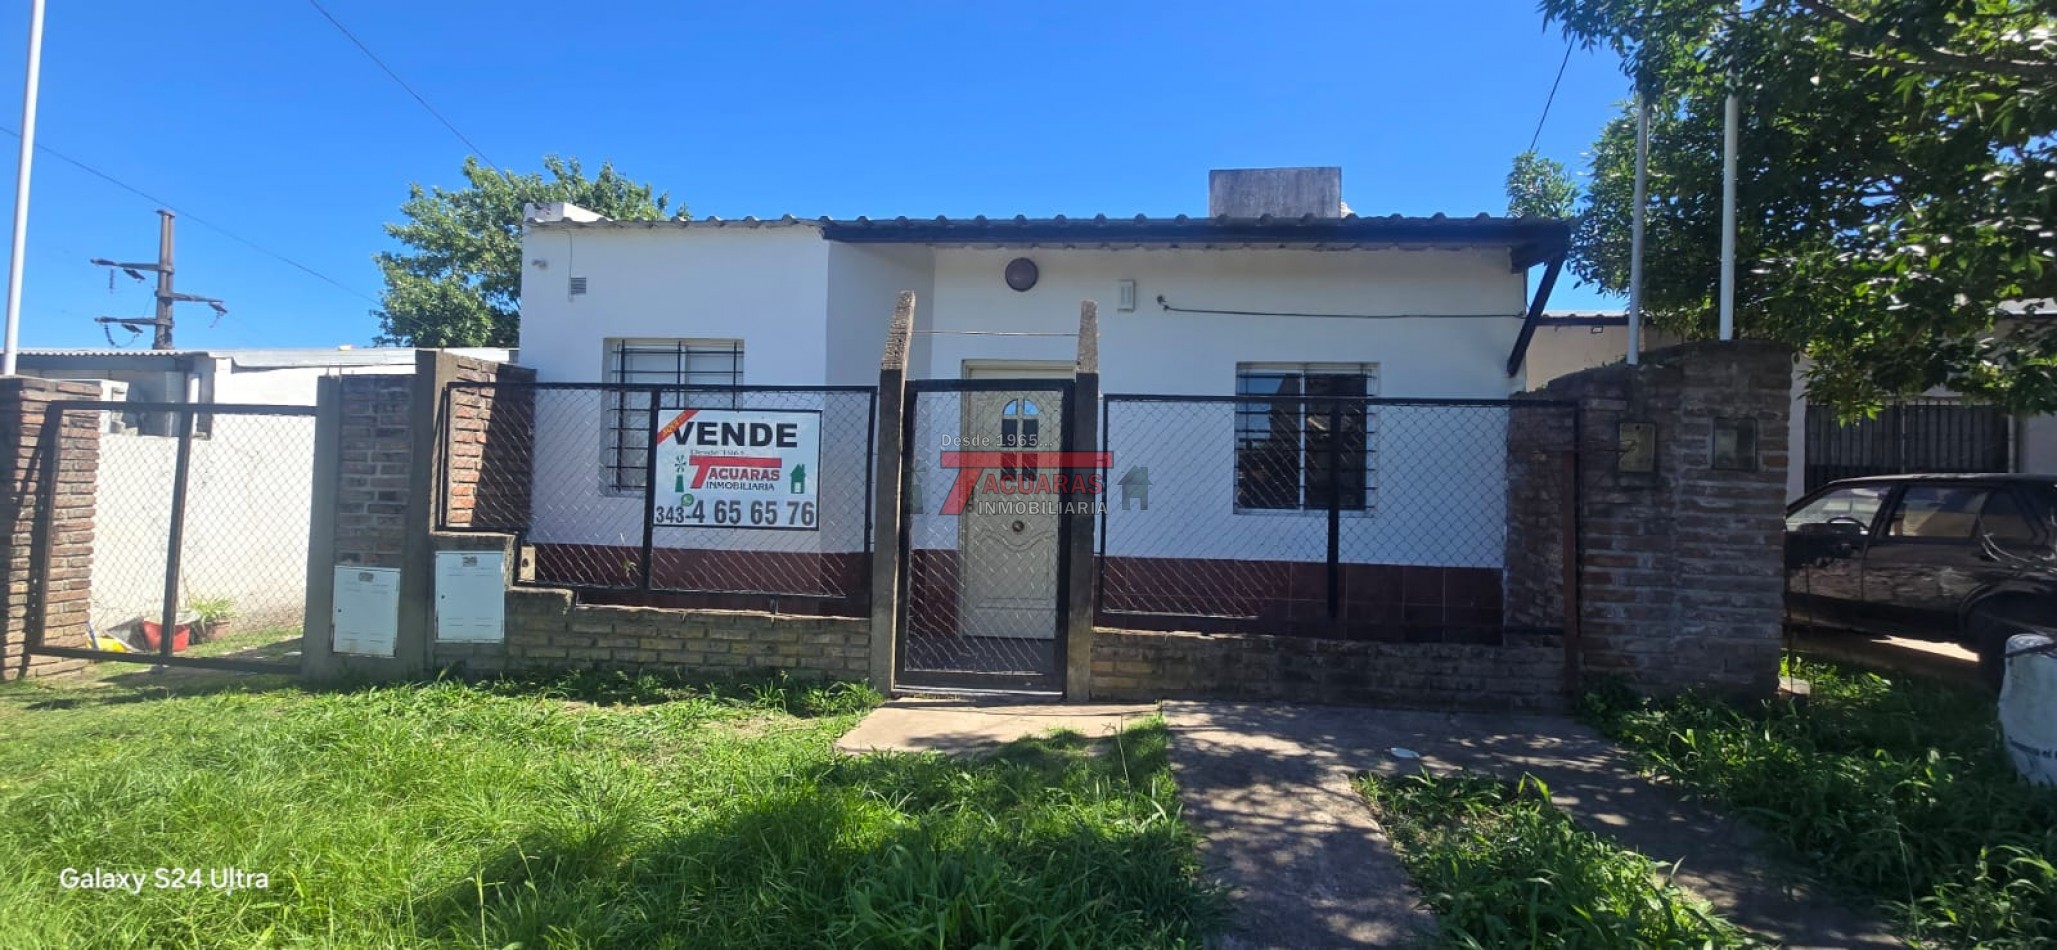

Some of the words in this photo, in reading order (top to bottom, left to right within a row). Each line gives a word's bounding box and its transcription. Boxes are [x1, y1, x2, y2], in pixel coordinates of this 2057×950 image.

[674, 421, 798, 448] VENDE
[689, 455, 783, 489] TACUARAS
[706, 481, 775, 491] INMOBILIARIA
[714, 500, 741, 525] 65
[750, 500, 778, 525] 65
[787, 500, 815, 526] 76
